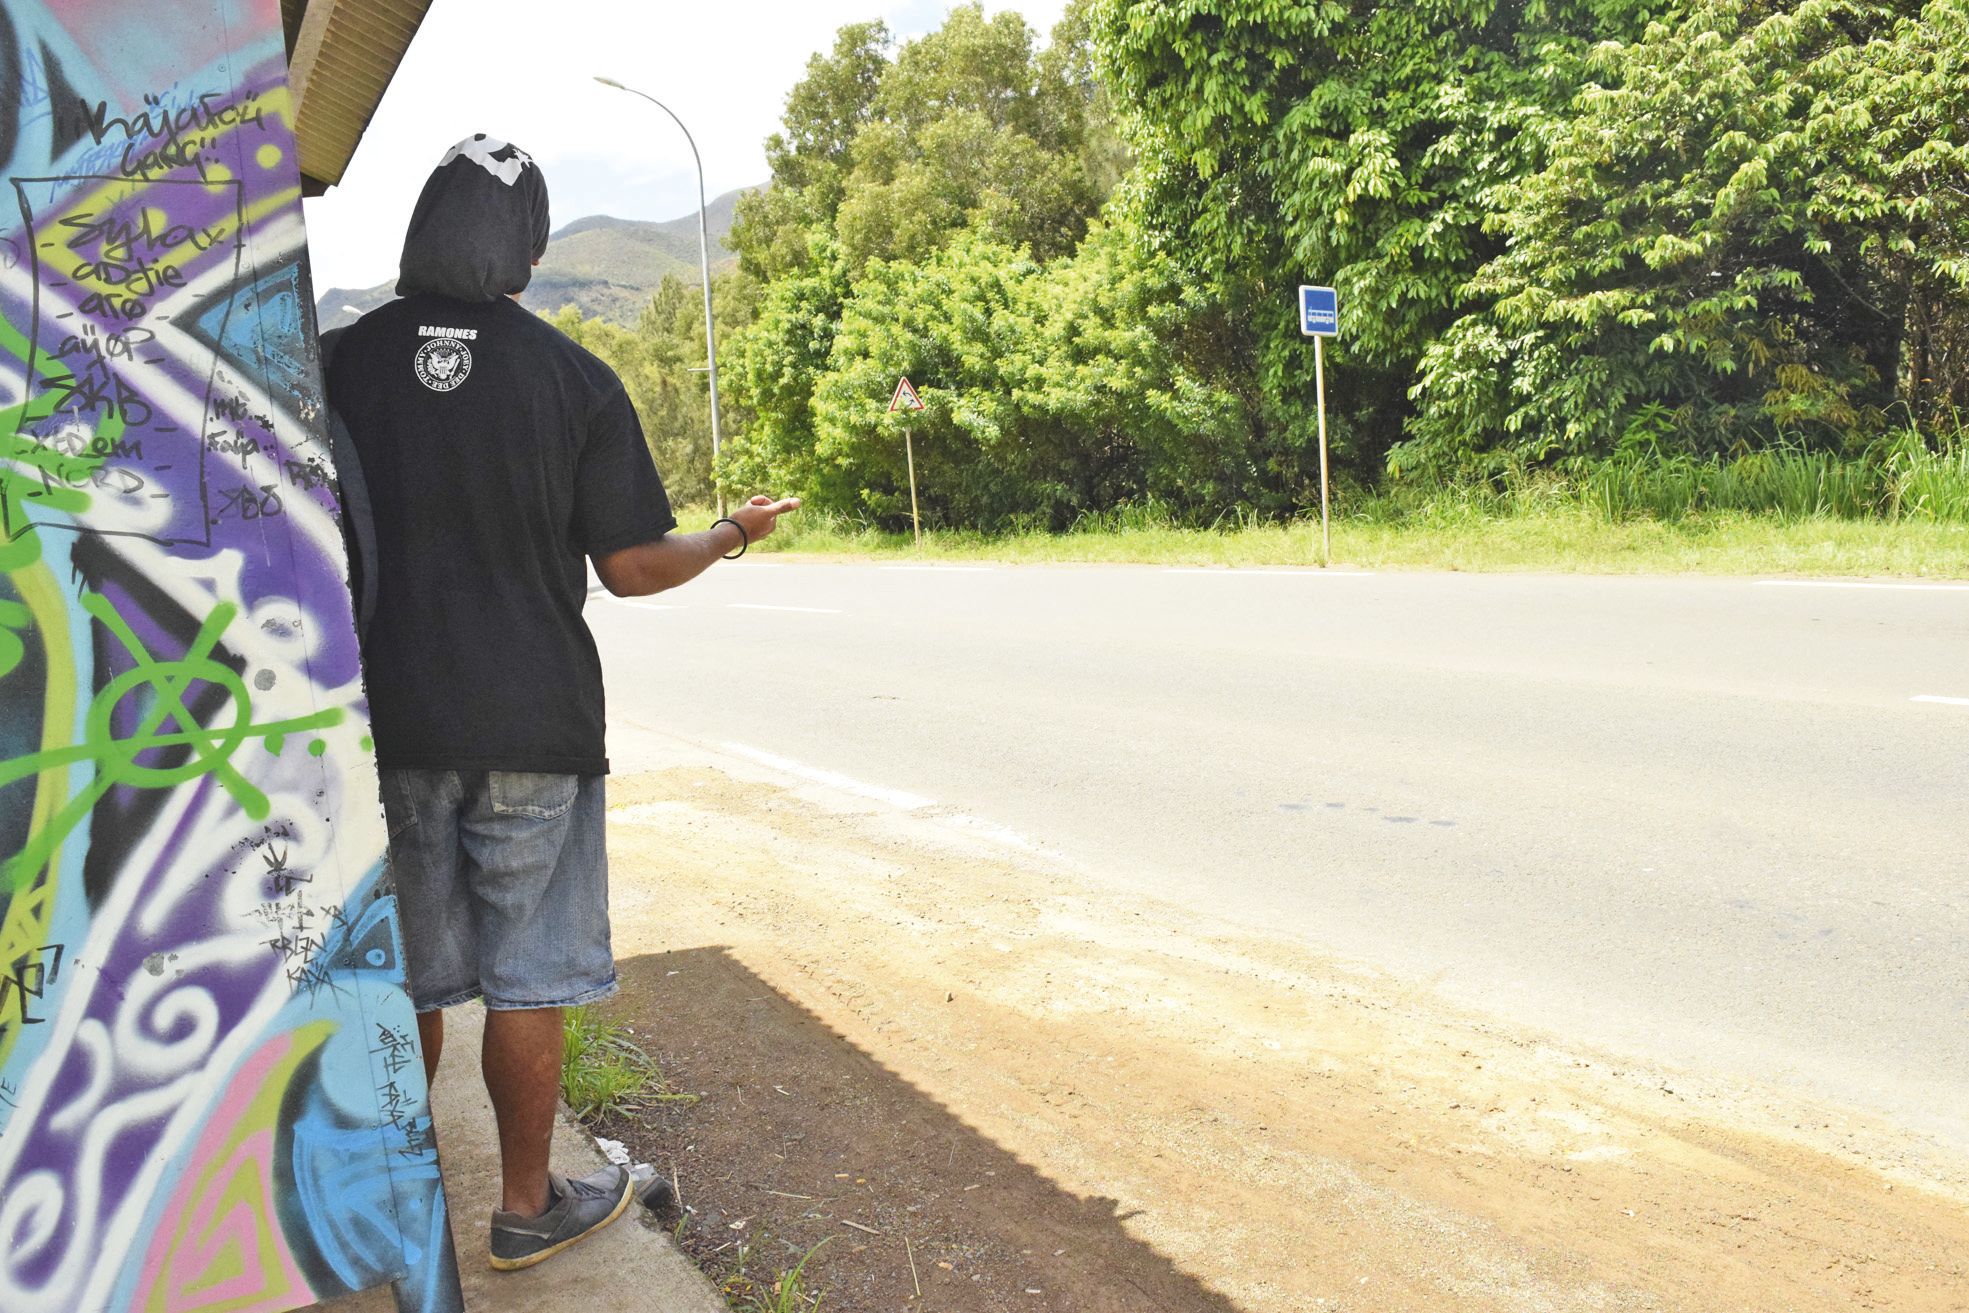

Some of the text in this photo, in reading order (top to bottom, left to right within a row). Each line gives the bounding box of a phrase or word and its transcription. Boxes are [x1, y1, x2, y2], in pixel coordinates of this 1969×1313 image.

[418, 325, 478, 340] RAMONES
[426, 340, 461, 352] JOHNNY
[417, 351, 429, 383] TOMMY
[461, 350, 470, 370] JOEY
